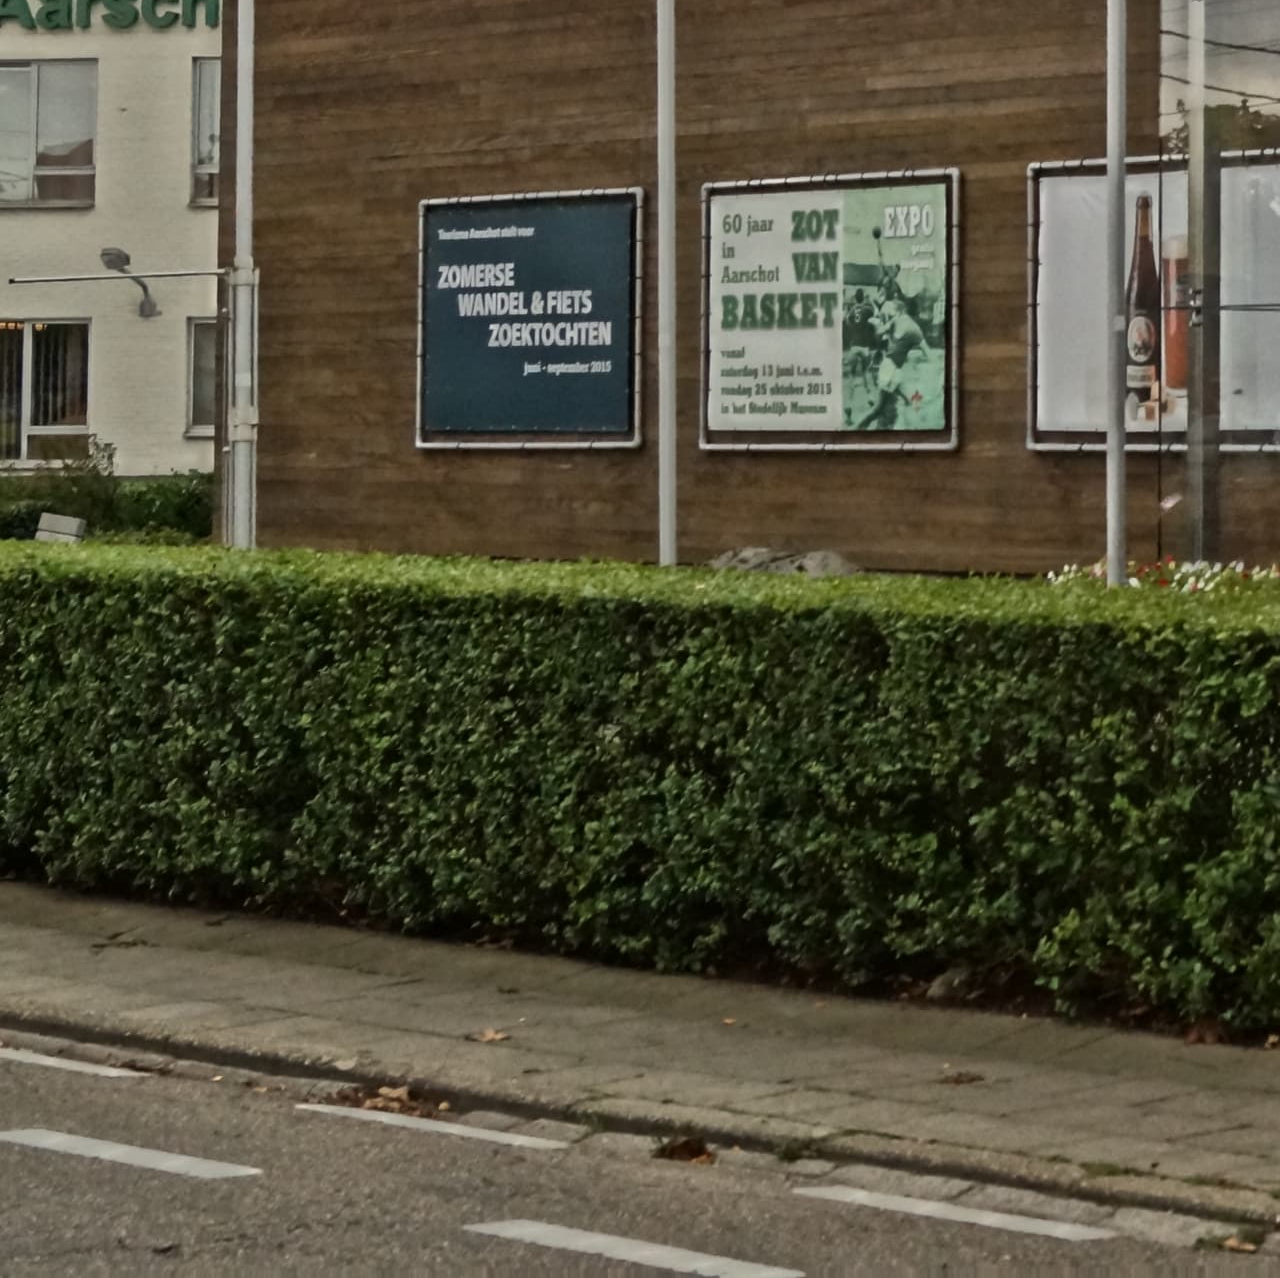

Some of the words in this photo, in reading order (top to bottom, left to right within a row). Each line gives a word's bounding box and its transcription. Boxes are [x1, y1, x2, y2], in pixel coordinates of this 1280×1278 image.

[721, 214, 742, 234] 60
[746, 216, 774, 236] jaar
[790, 209, 839, 242] ZOT
[884, 205, 934, 237] EXPO
[721, 242, 735, 259] in
[437, 262, 515, 289] ZOMERSE
[721, 265, 780, 284] Aarschot
[790, 251, 839, 283] VAN
[457, 291, 529, 317] WANDEL
[531, 291, 544, 315] &
[547, 290, 592, 315] FIETS
[721, 292, 838, 331] BASKET
[488, 322, 612, 347] ZOEKTOCHTEN
[807, 383, 833, 395] 2015
